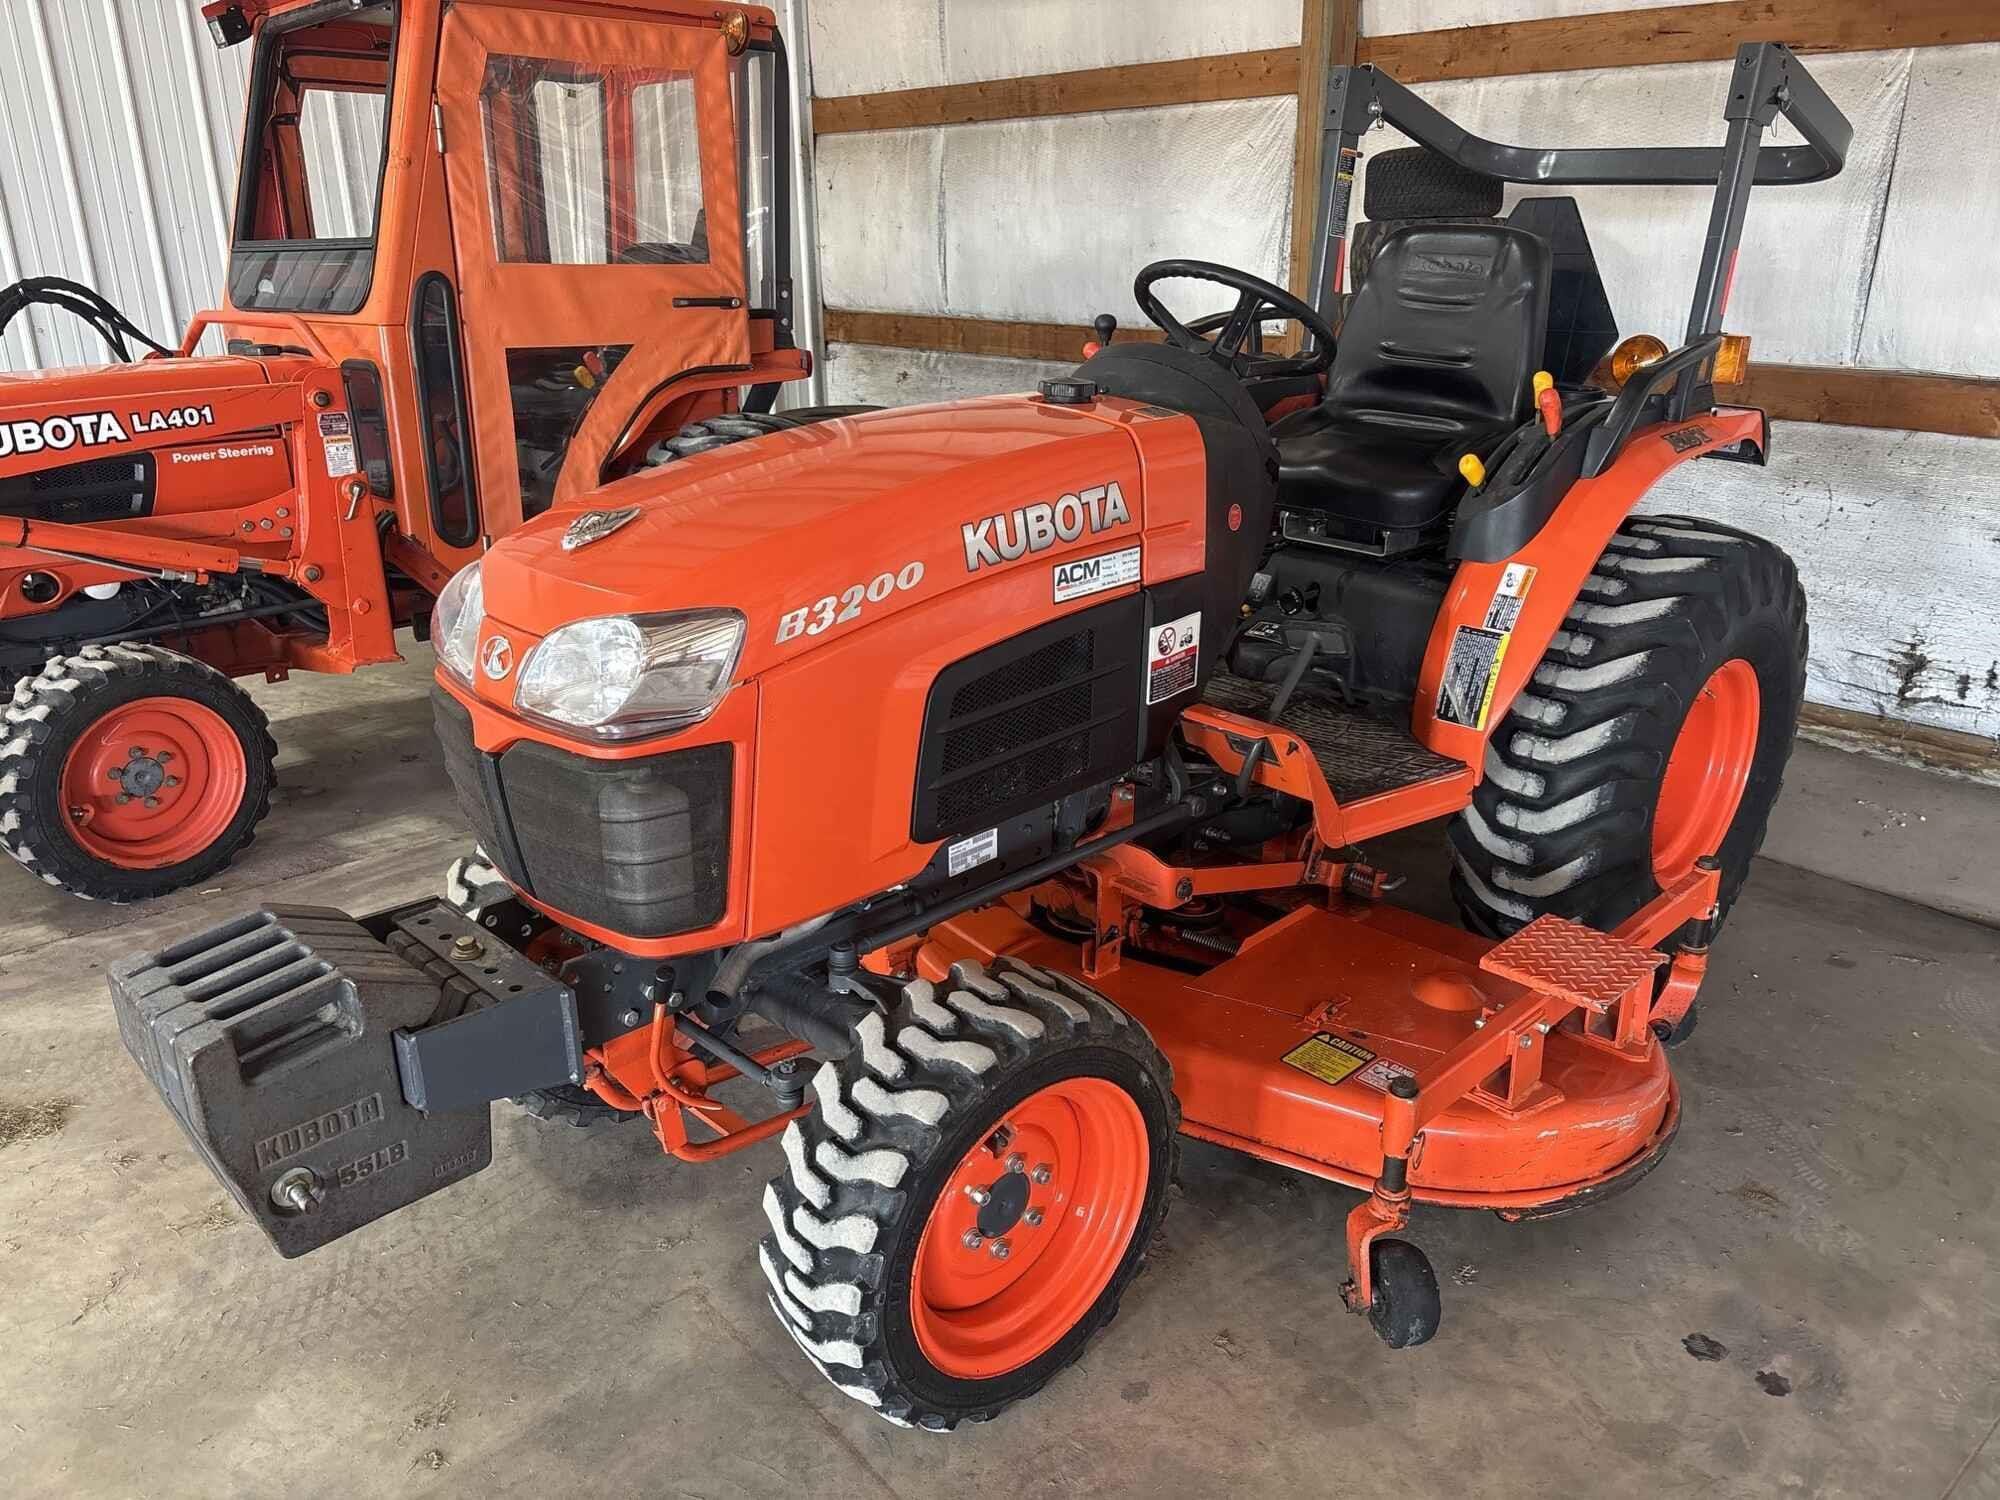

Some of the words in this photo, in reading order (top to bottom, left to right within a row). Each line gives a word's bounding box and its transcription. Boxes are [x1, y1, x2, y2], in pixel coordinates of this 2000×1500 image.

[129, 405, 215, 433] LA401
[172, 451, 217, 464] Power
[217, 445, 274, 459] Steering
[961, 481, 1131, 573] KUBOTA
[1056, 559, 1100, 586] ACM
[774, 560, 925, 645] B3200
[1329, 1038, 1376, 1061] CAUTION
[1390, 1064, 1416, 1078] DANG
[254, 1093, 385, 1172] KUBOTA
[337, 1139, 409, 1188] 55LB
